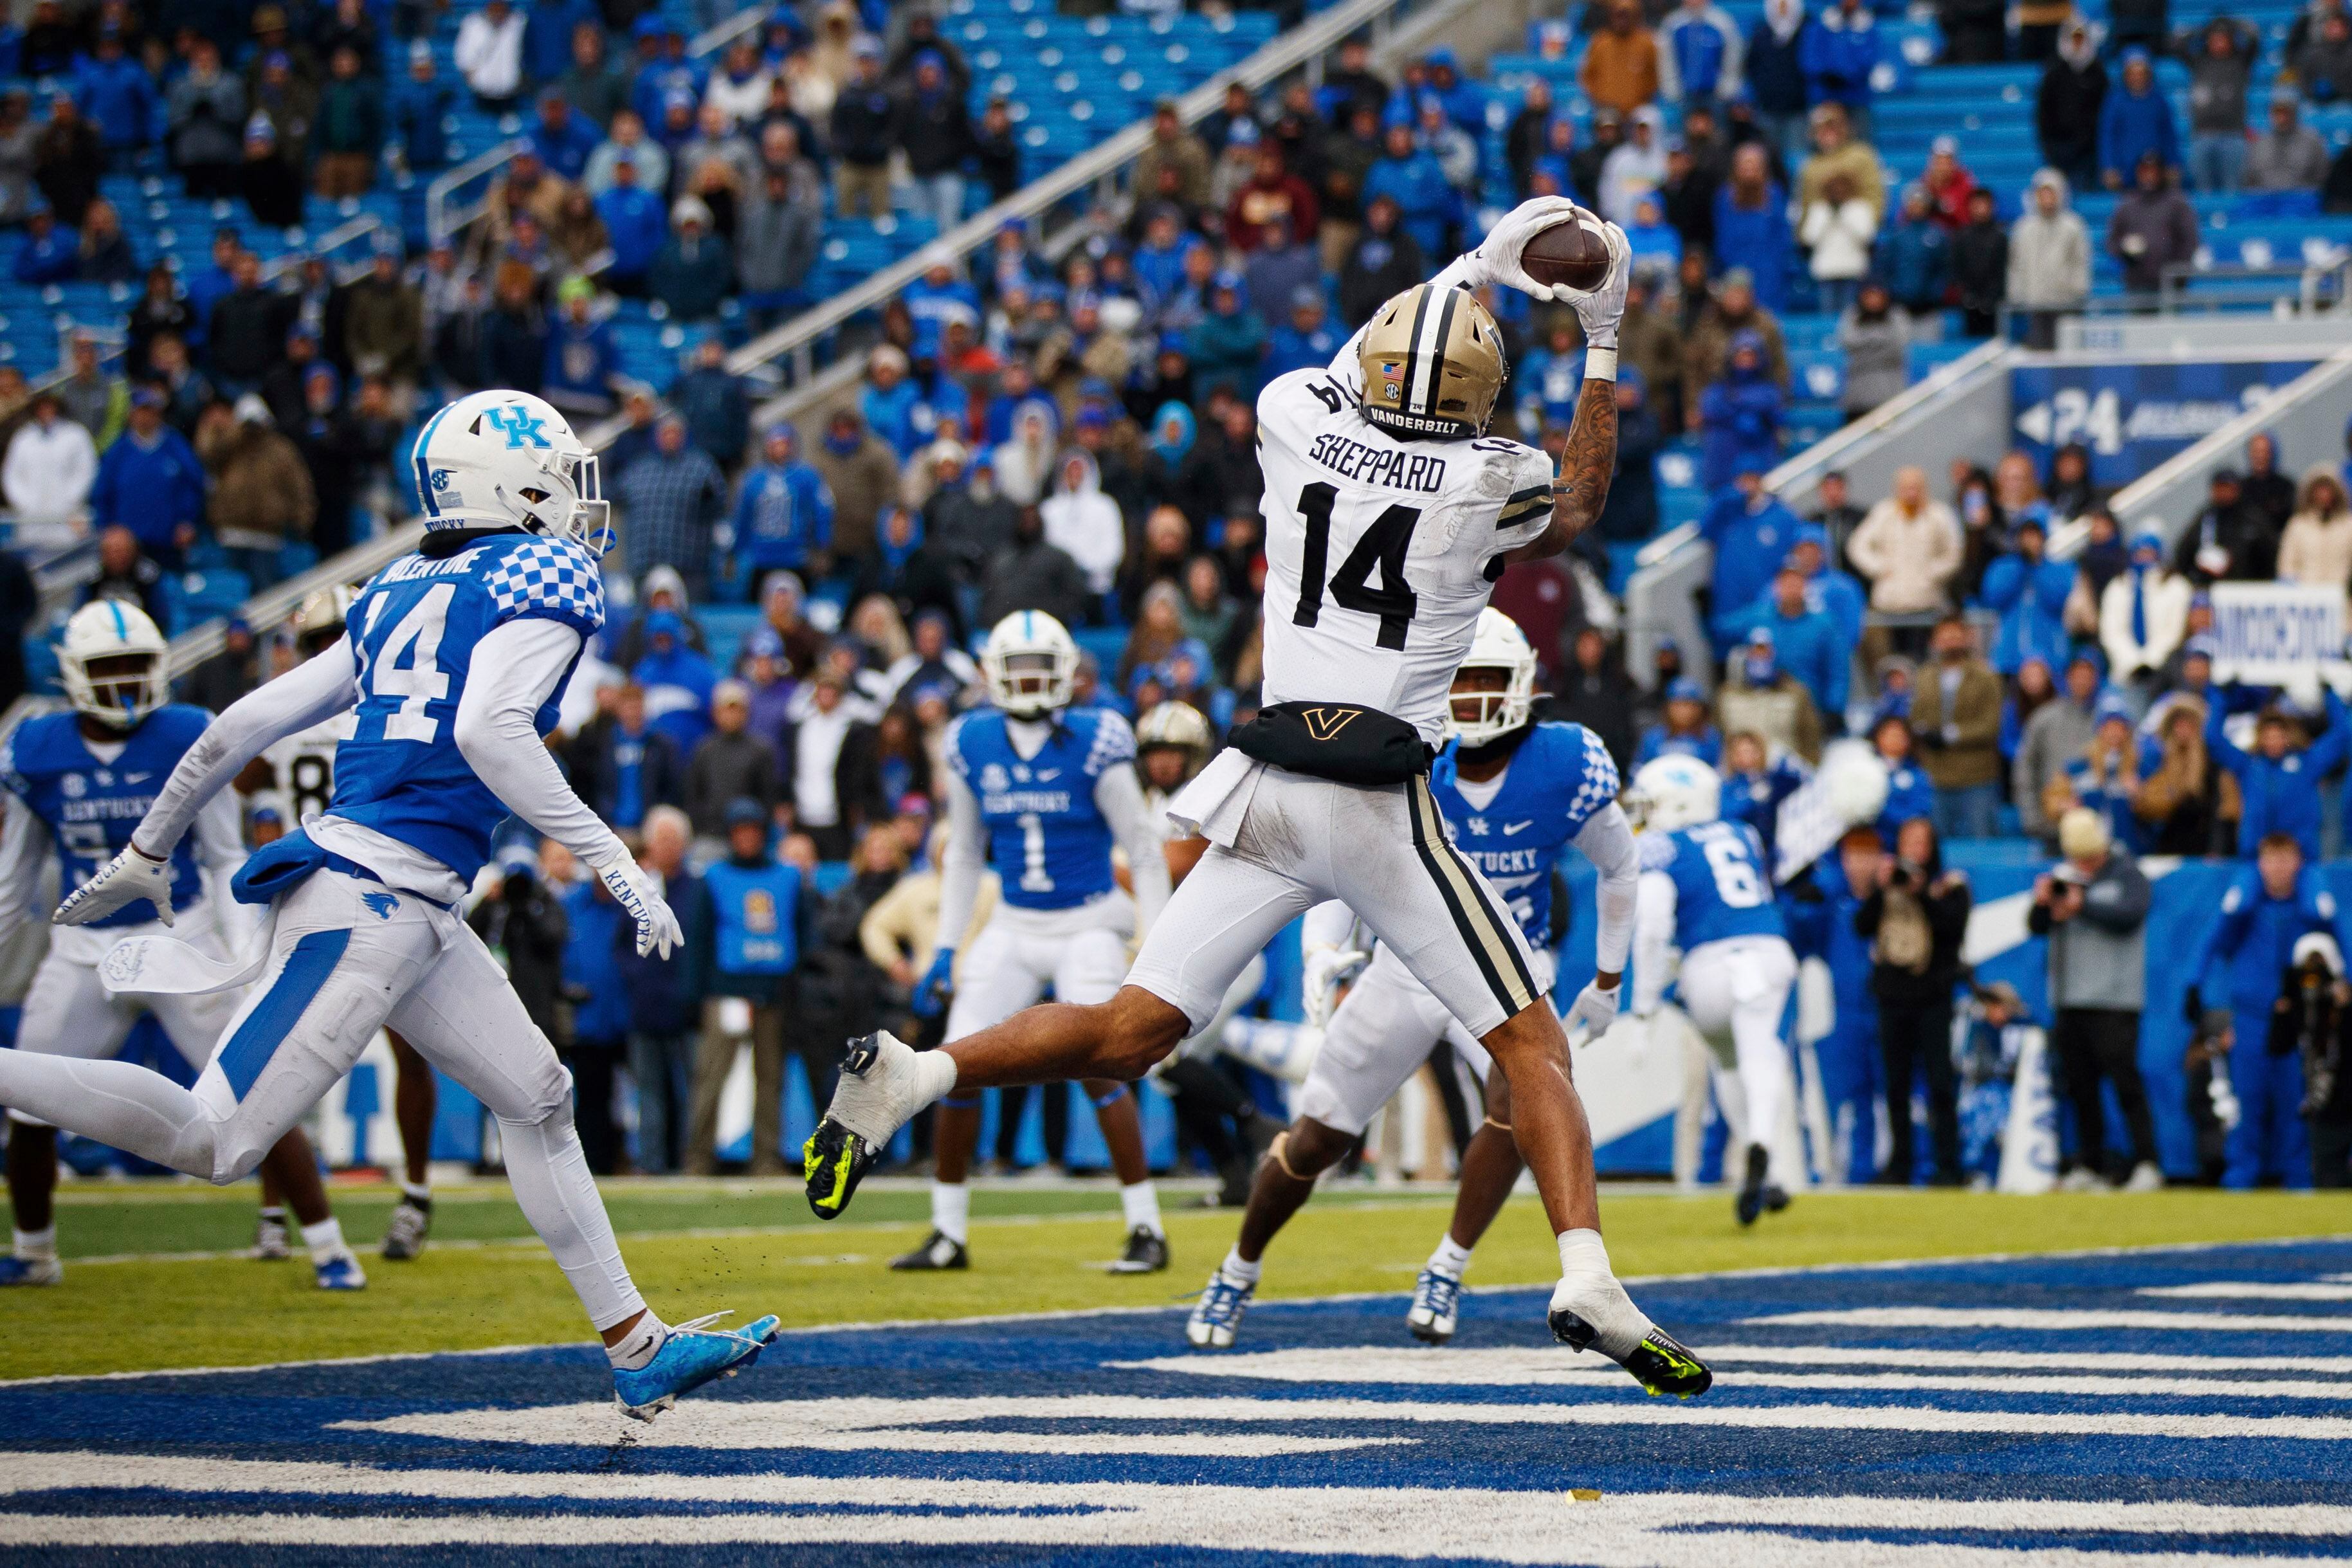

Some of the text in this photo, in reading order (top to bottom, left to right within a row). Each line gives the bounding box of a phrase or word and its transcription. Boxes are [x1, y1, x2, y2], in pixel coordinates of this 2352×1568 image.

[1371, 407, 1459, 434] VANDERBILT
[1385, 383, 1399, 400] SEC
[2055, 388, 2120, 455] 24
[482, 406, 552, 450] UK
[1309, 433, 1446, 493] SHEPPARD
[1292, 481, 1422, 652] 14
[339, 583, 456, 743] 14
[1301, 708, 1363, 740] V
[1016, 814, 1055, 892] 1
[1704, 839, 1762, 908] 6
[605, 870, 651, 947] KENTUCKY
